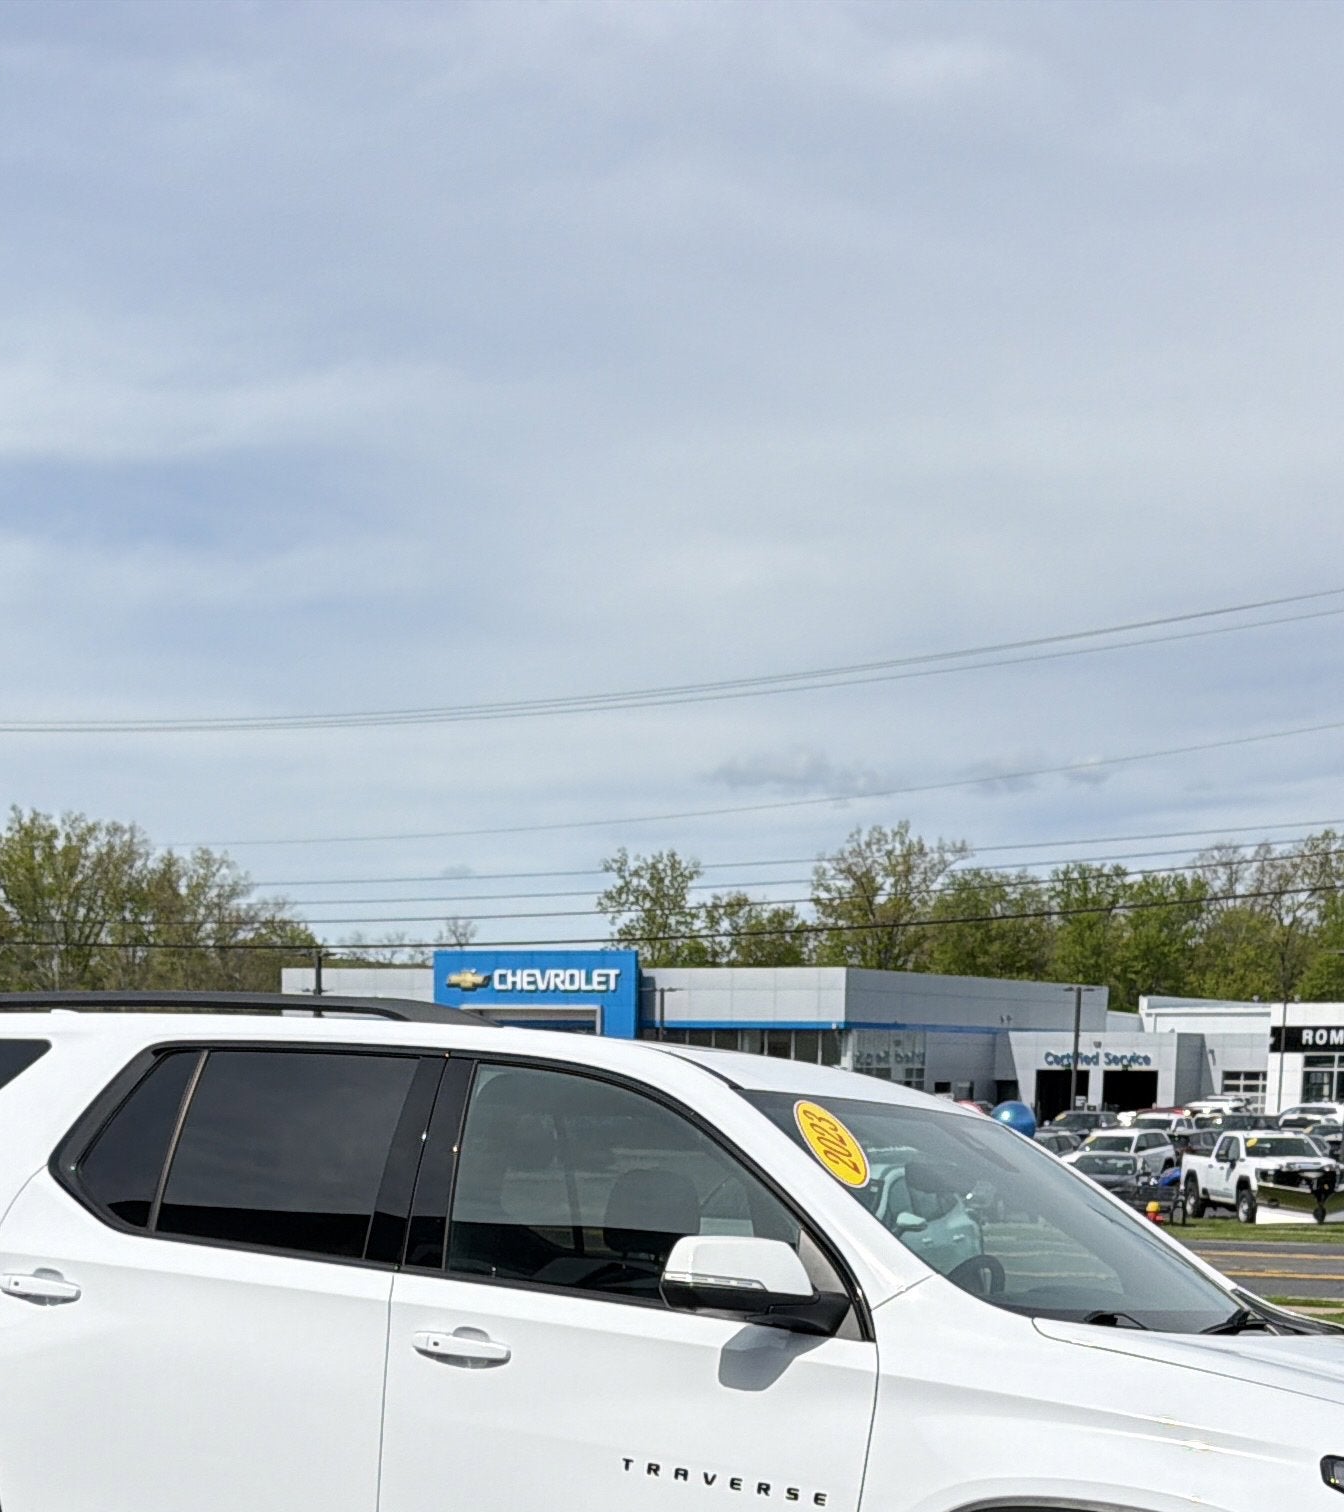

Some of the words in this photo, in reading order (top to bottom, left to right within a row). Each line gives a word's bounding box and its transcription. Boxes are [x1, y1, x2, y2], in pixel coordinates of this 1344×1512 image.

[493, 968, 621, 992] CHEVROLET
[1044, 1051, 1100, 1066] Certied
[1103, 1051, 1152, 1066] Service
[803, 1109, 861, 1174] 2023
[622, 1457, 828, 1507] TRAVERSE
